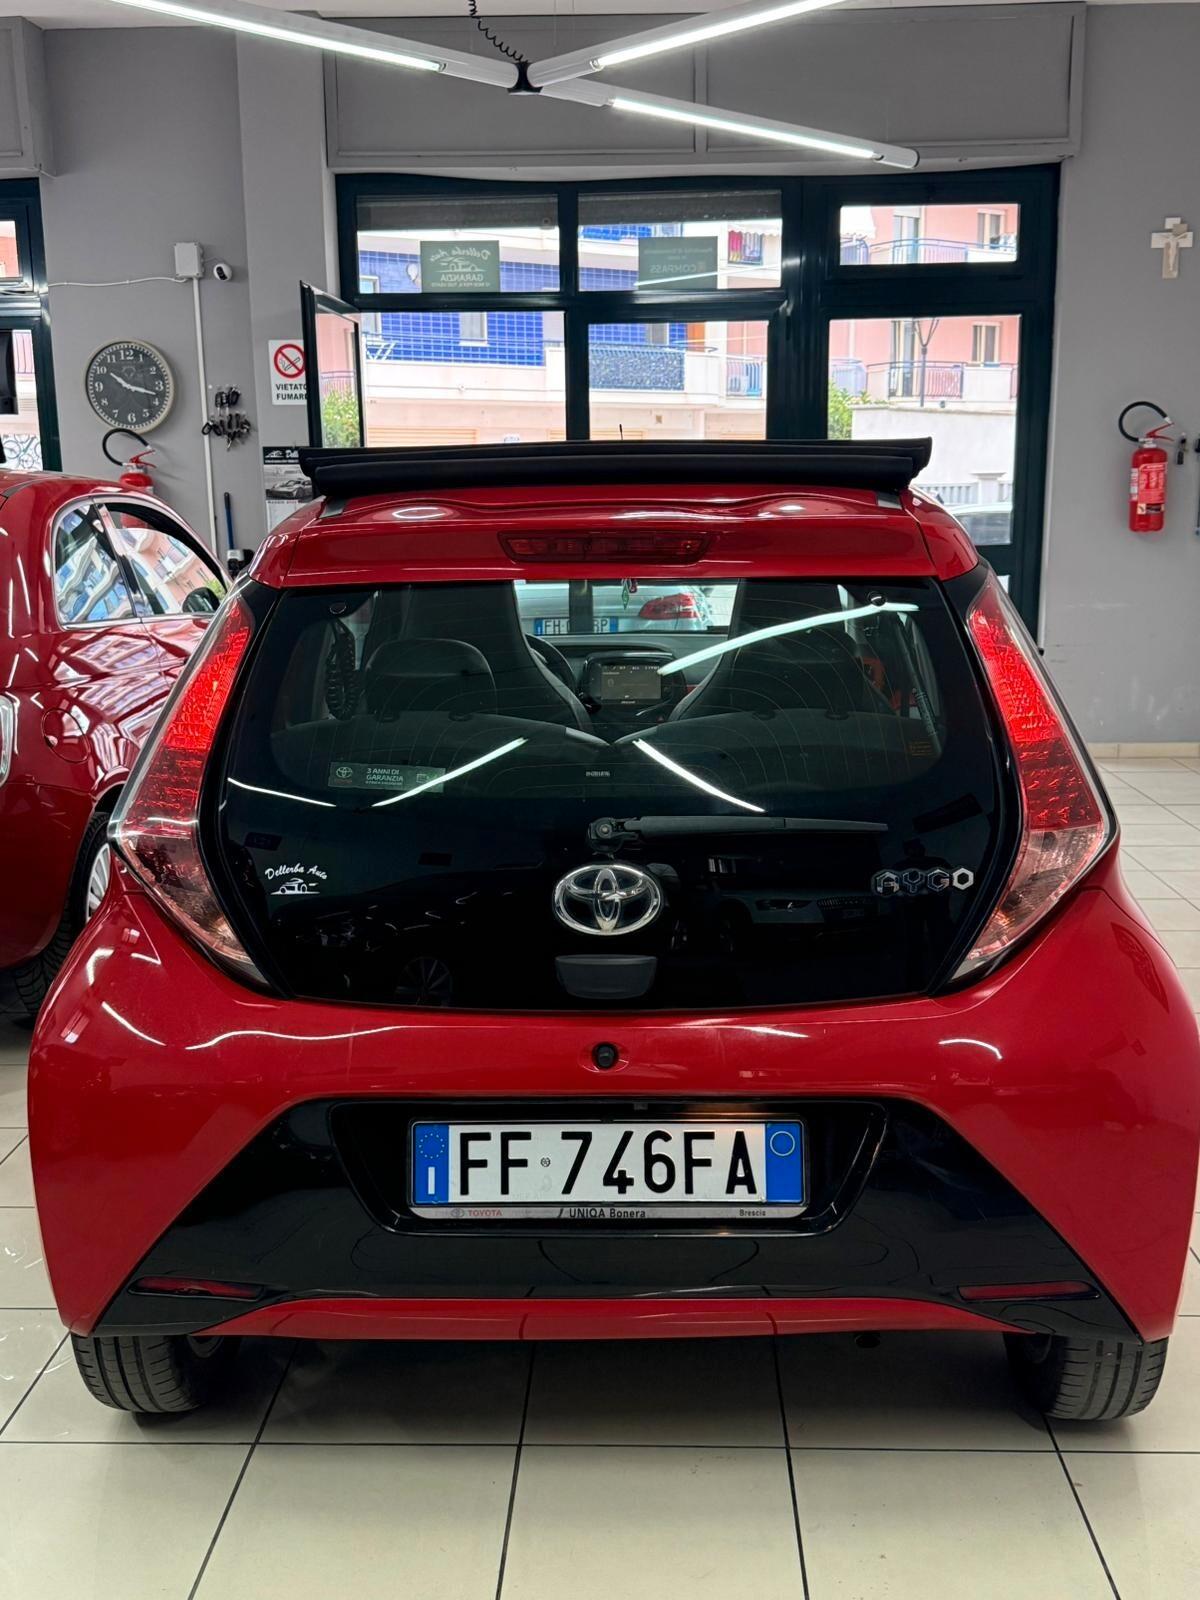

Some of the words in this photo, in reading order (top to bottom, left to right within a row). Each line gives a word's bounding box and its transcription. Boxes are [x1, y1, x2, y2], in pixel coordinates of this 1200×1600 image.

[106, 354, 116, 363] 11
[120, 349, 134, 361] 12
[139, 353, 144, 362] 1
[96, 366, 107, 375] 10
[149, 366, 157, 375] 2
[94, 381, 104, 393] 9
[154, 380, 164, 392] 3
[101, 398, 109, 406] 8
[152, 398, 160, 406] 4
[112, 409, 119, 418] 7
[142, 408, 150, 417] 5
[127, 412, 137, 424] 6
[366, 767, 372, 775] 3
[366, 774, 404, 782] GARANZIA
[264, 862, 305, 880] Dellerba
[306, 865, 328, 880] Auto
[875, 867, 974, 894] AYGO
[459, 1131, 533, 1196] FF
[561, 1130, 758, 1195] 746FA
[427, 1166, 436, 1195] I
[468, 1209, 503, 1217] TOYOTA
[569, 1208, 606, 1219] UNIQA
[609, 1208, 646, 1218] Bonera
[738, 1208, 767, 1217] Brescia
